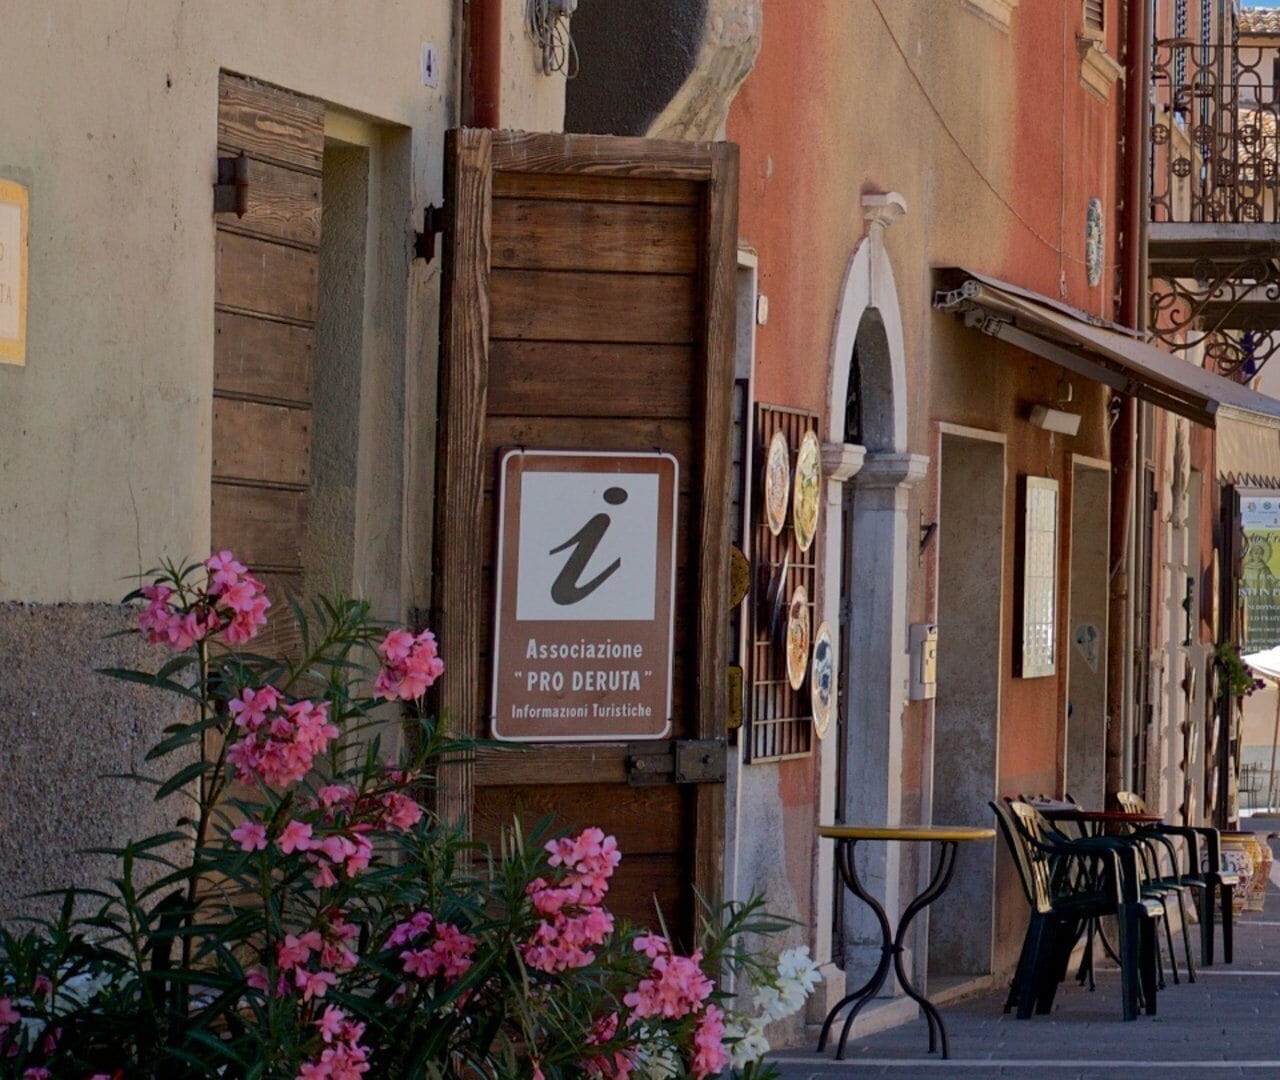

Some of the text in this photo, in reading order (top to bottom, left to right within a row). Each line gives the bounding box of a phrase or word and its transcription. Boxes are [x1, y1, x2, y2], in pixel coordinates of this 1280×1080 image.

[526, 638, 643, 660] Associazione
[511, 703, 652, 718] Informazioni Turistiche
